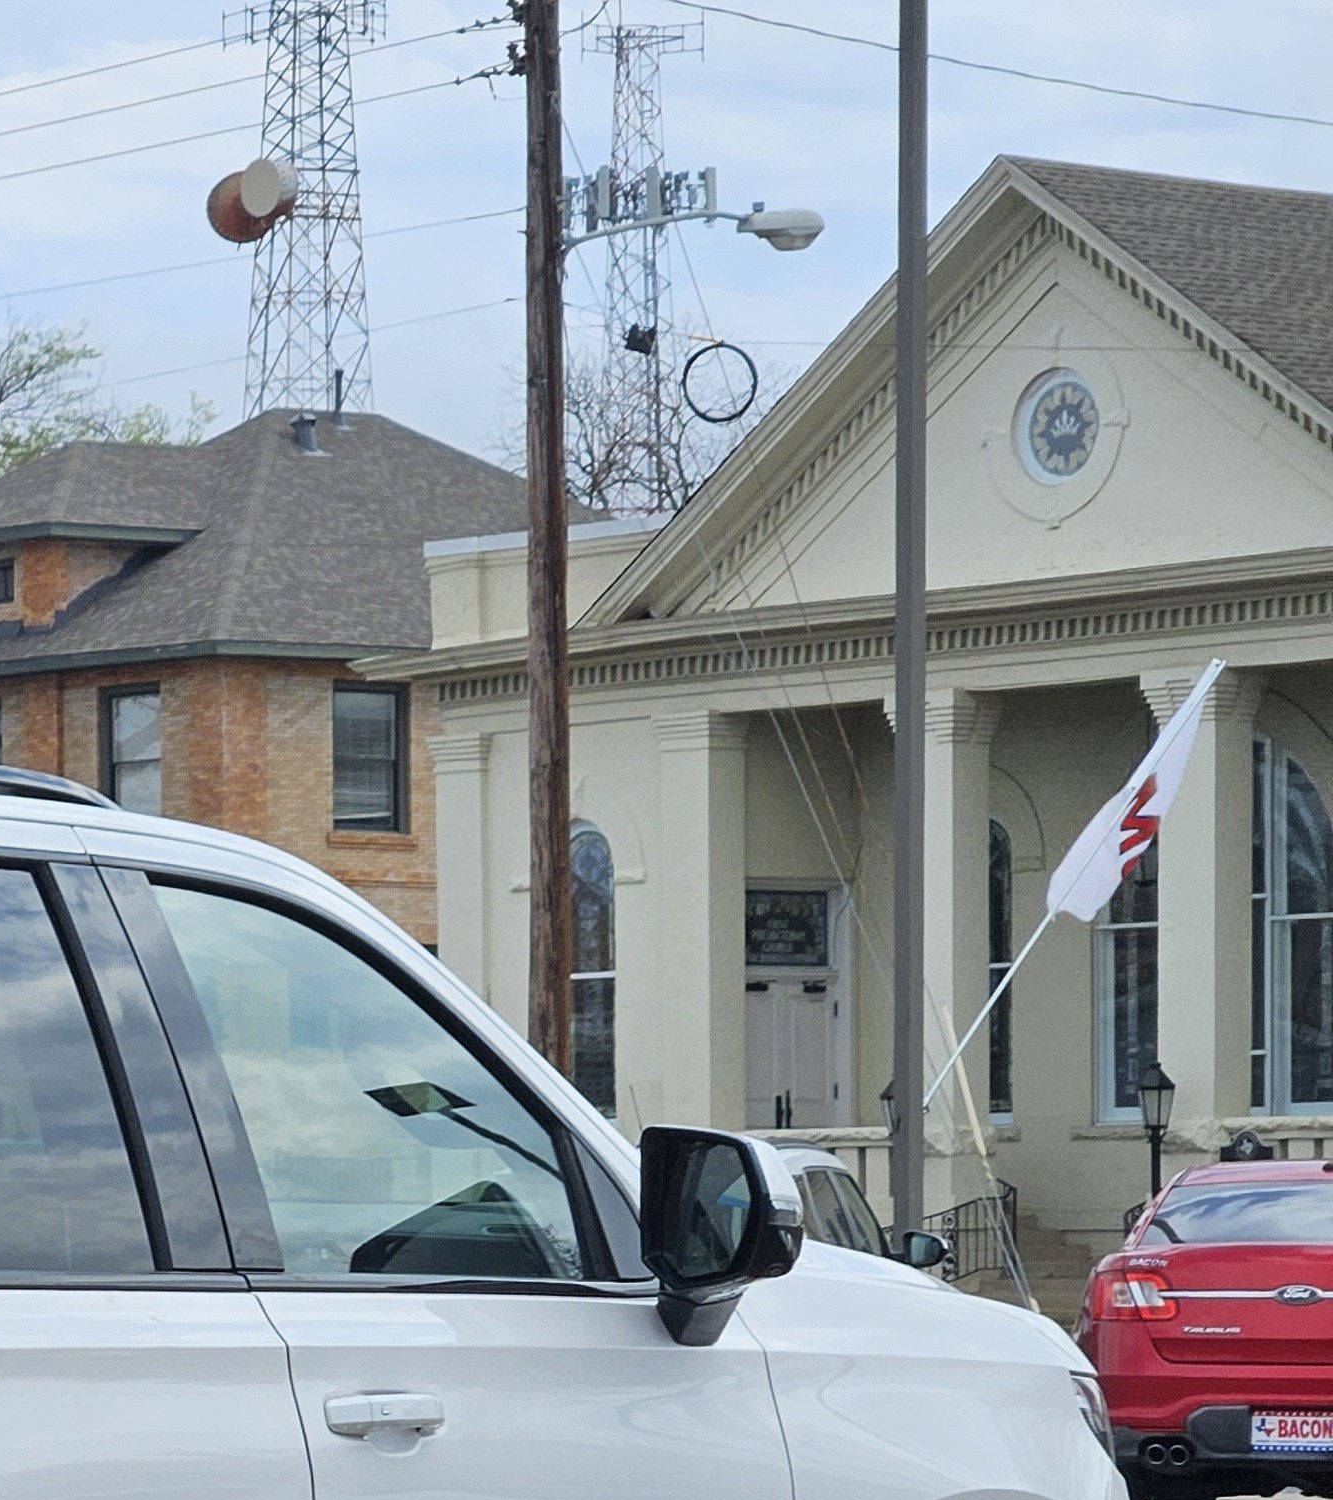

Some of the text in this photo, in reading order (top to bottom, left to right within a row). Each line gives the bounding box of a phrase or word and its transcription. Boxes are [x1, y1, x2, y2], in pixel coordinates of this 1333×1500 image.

[1128, 1257, 1170, 1268] BACON
[1182, 1325, 1242, 1335] TAURUS
[1277, 1418, 1333, 1439] BACON
